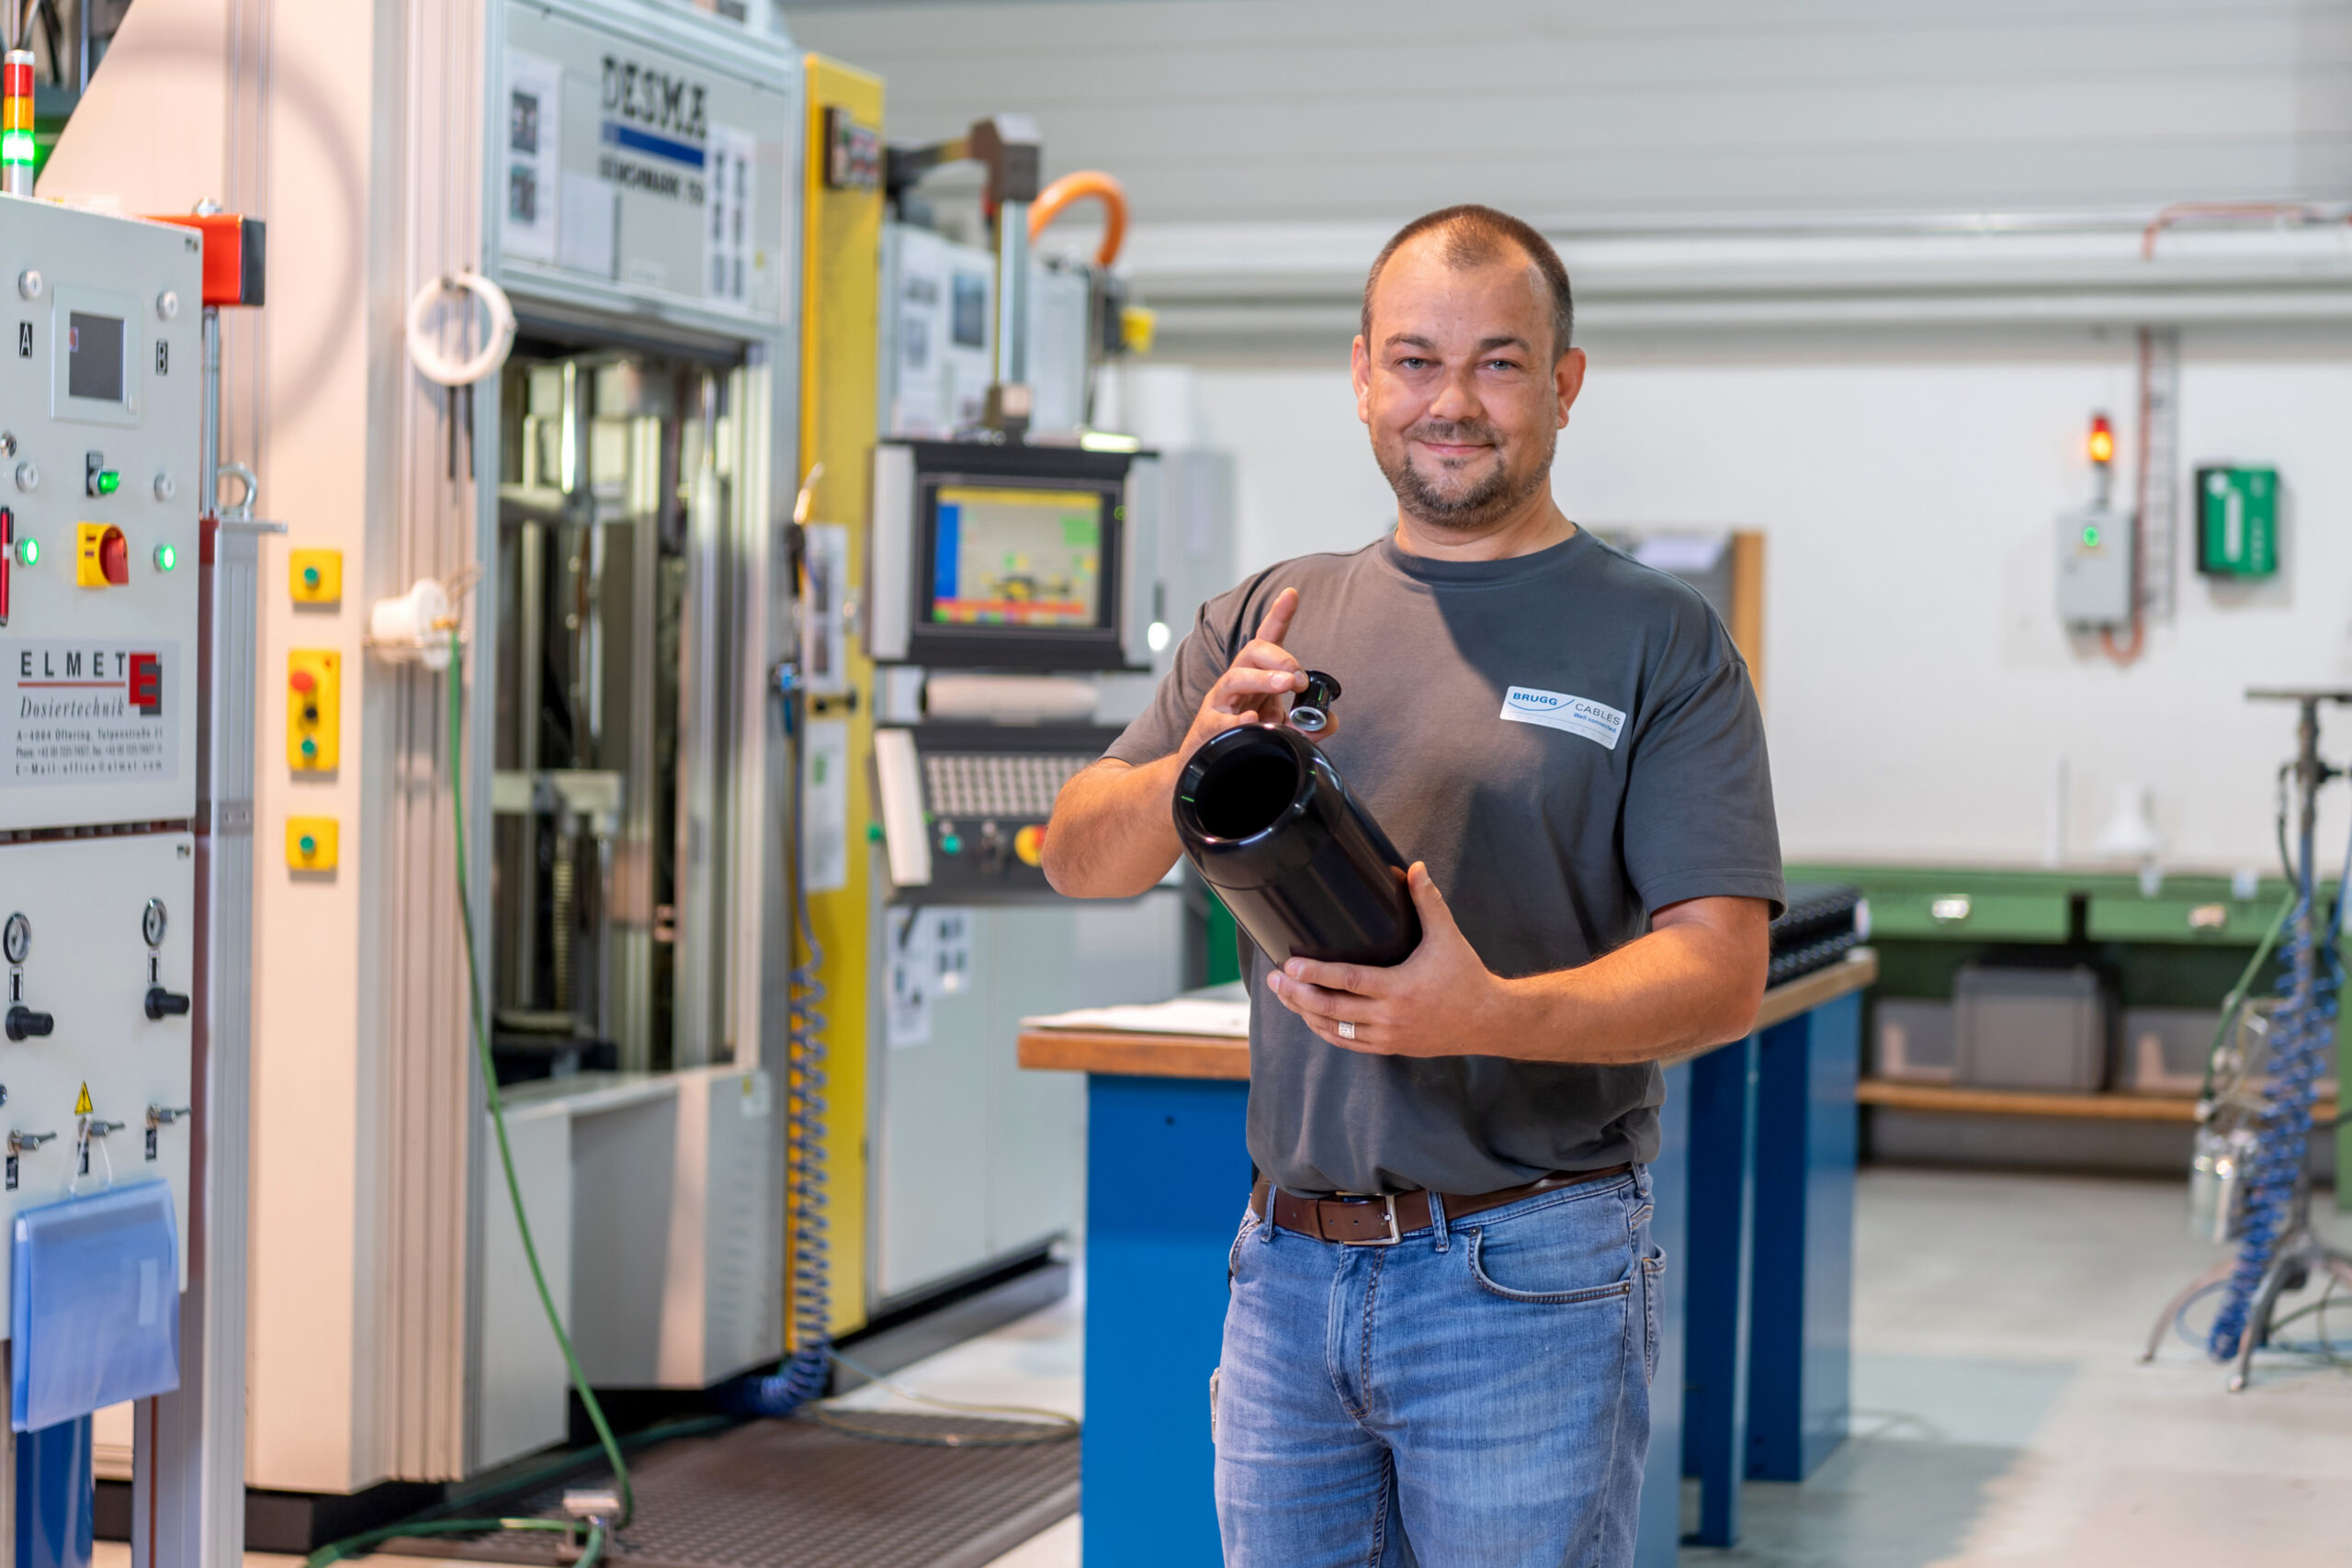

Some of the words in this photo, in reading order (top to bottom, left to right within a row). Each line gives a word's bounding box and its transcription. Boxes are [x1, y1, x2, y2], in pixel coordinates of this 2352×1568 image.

[603, 55, 707, 139] DESMA
[19, 322, 32, 357] A
[155, 340, 168, 375] B
[20, 650, 126, 678] ELMET
[20, 694, 125, 719] Dosiertechnik
[1512, 692, 1558, 706] BRUGG
[1575, 703, 1621, 726] CABLES
[1573, 712, 1588, 721] Well
[1588, 716, 1617, 733] connected
